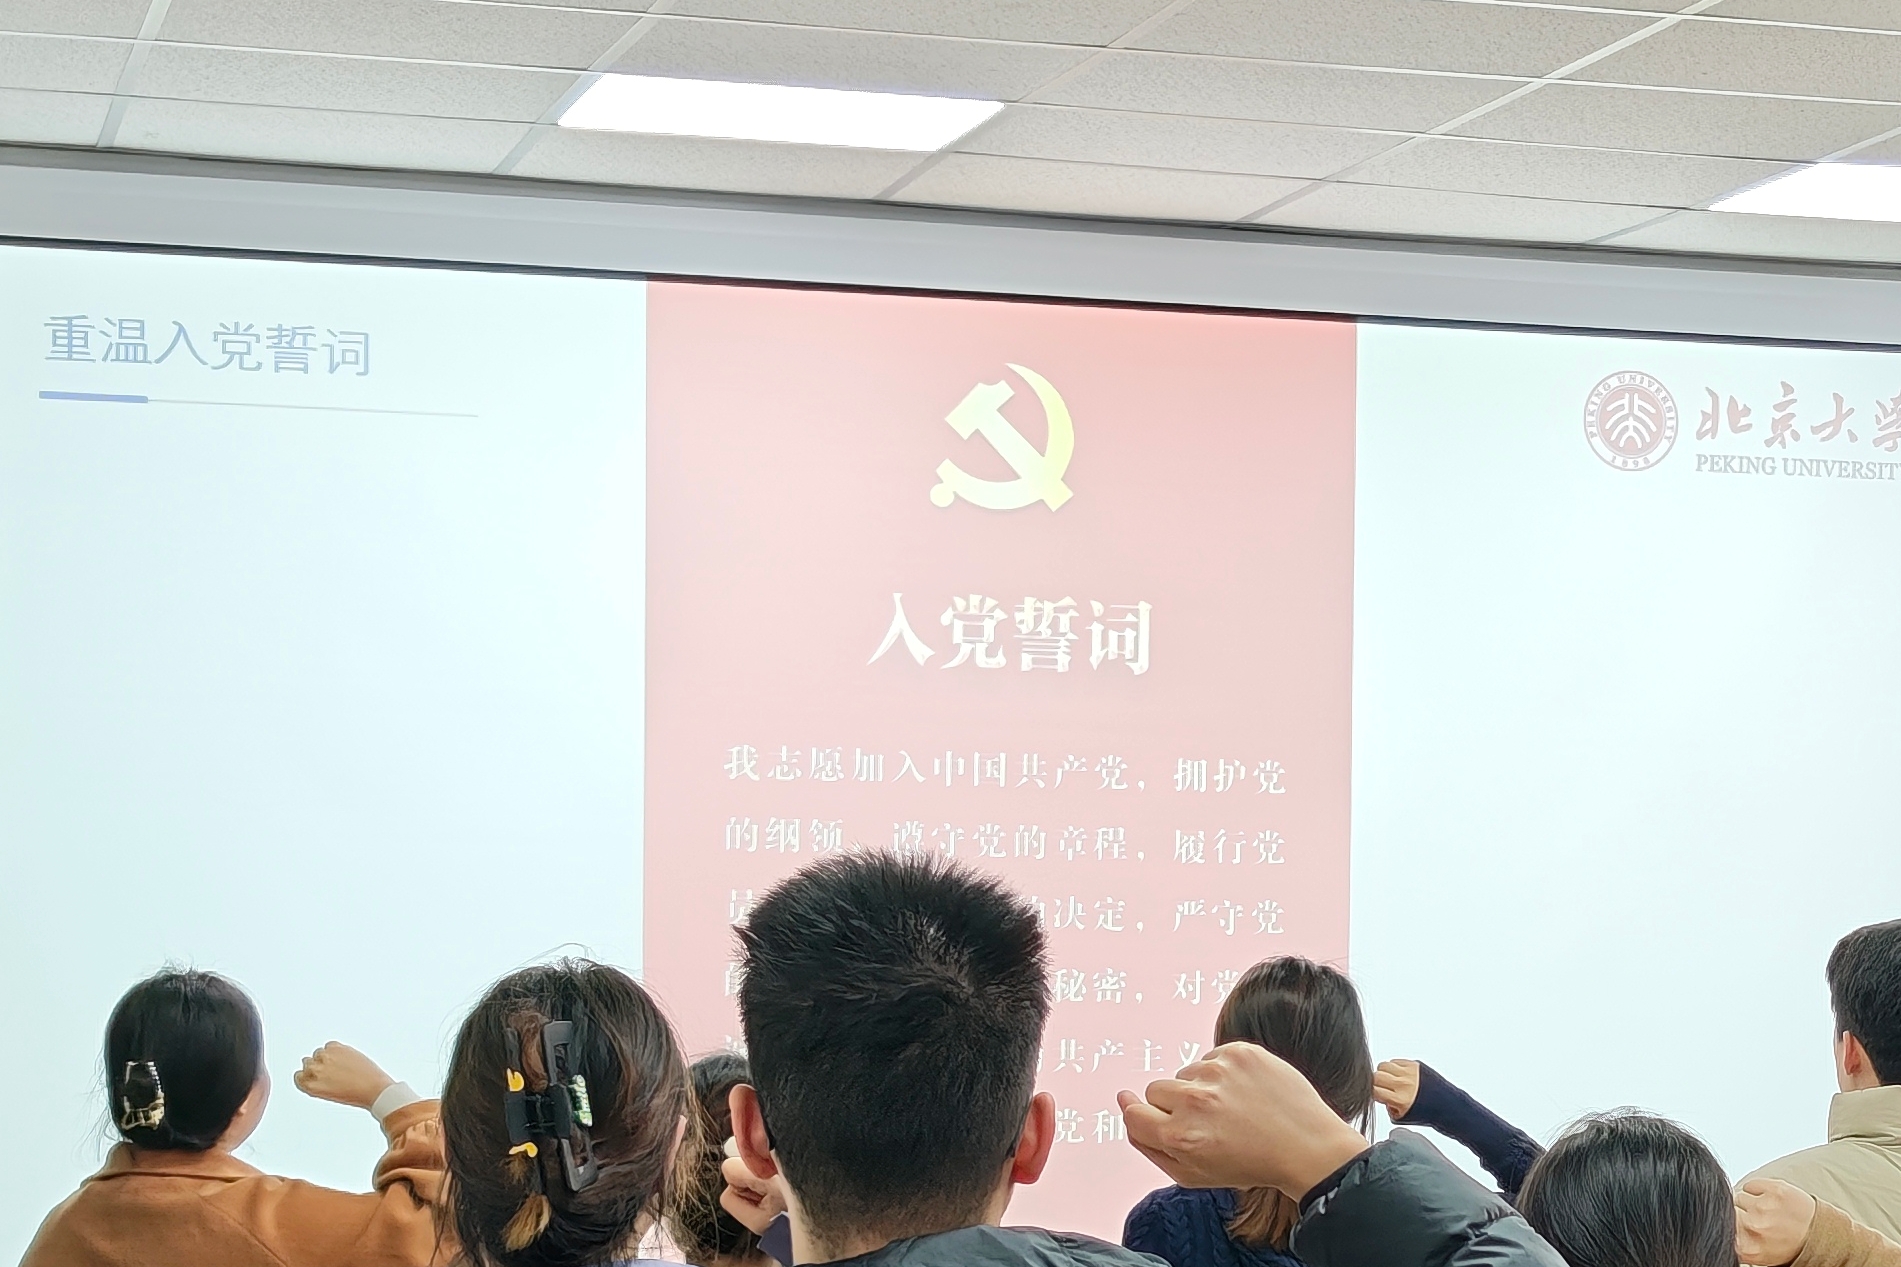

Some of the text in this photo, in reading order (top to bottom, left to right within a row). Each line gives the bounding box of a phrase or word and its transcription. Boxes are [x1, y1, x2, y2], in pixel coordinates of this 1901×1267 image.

[43, 315, 370, 376] 重温入党誓词
[1695, 453, 1776, 476] PEKING
[866, 592, 1153, 676] 入党誓词
[723, 744, 1287, 794] 我志愿加入中国共产党，拥护党
[724, 816, 1286, 865] 的纲领遵守党的章程，履行党
